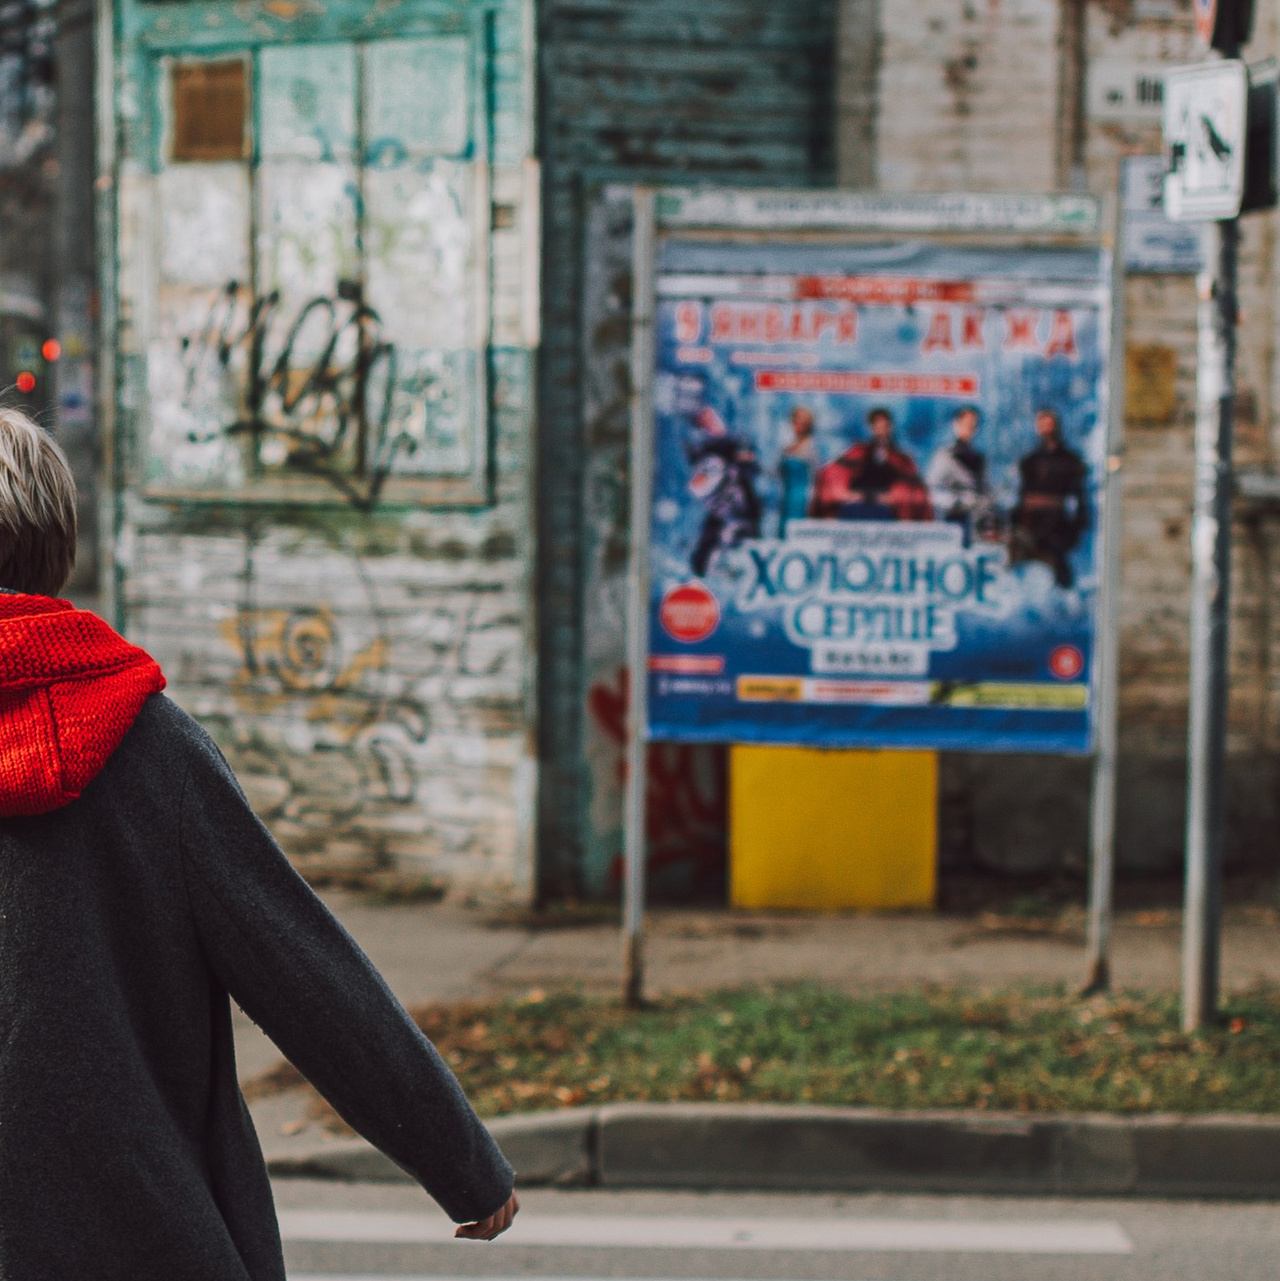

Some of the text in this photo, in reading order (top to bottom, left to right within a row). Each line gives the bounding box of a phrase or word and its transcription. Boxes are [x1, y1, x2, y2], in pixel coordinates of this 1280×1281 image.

[711, 305, 857, 344] ЯНВАРЯ
[923, 310, 1079, 358] ДК ЖД
[744, 549, 1004, 605] ХОЛОДНОЕ
[793, 600, 951, 642] СЕРДЦЕ
